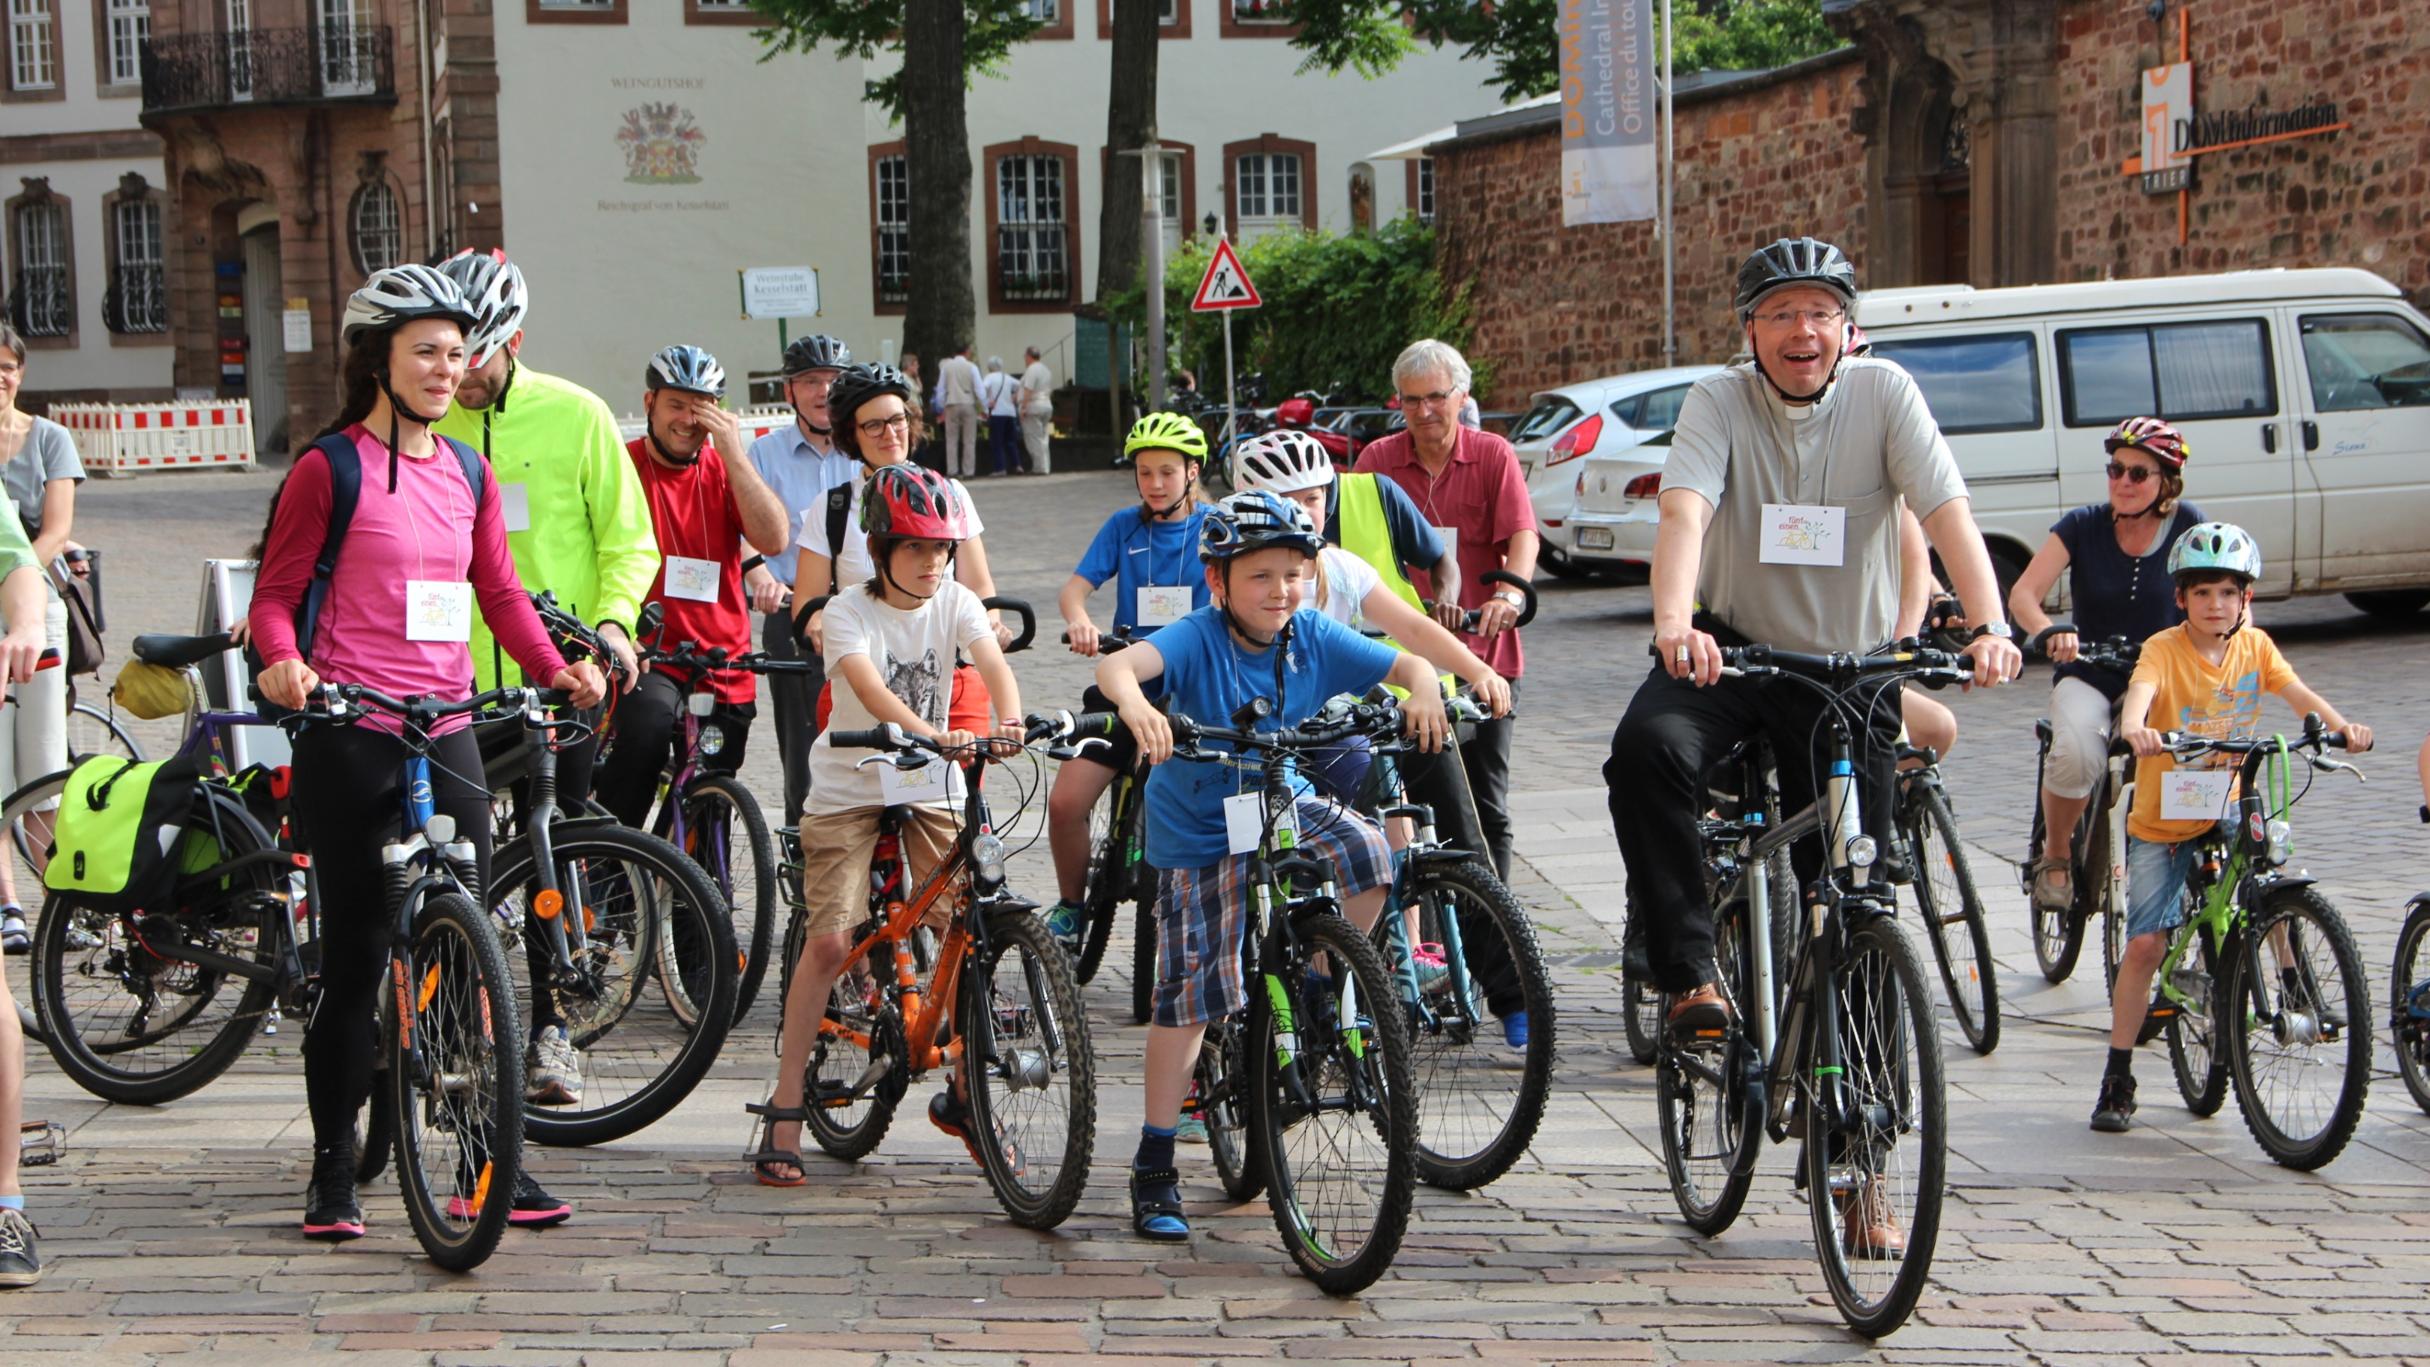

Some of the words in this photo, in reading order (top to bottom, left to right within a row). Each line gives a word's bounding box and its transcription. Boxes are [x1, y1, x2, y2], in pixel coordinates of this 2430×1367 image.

[1619, 34, 1638, 64] du
[1591, 24, 1615, 136] Cathedral
[1621, 67, 1642, 134] Office
[2144, 169, 2186, 190] TRIER
